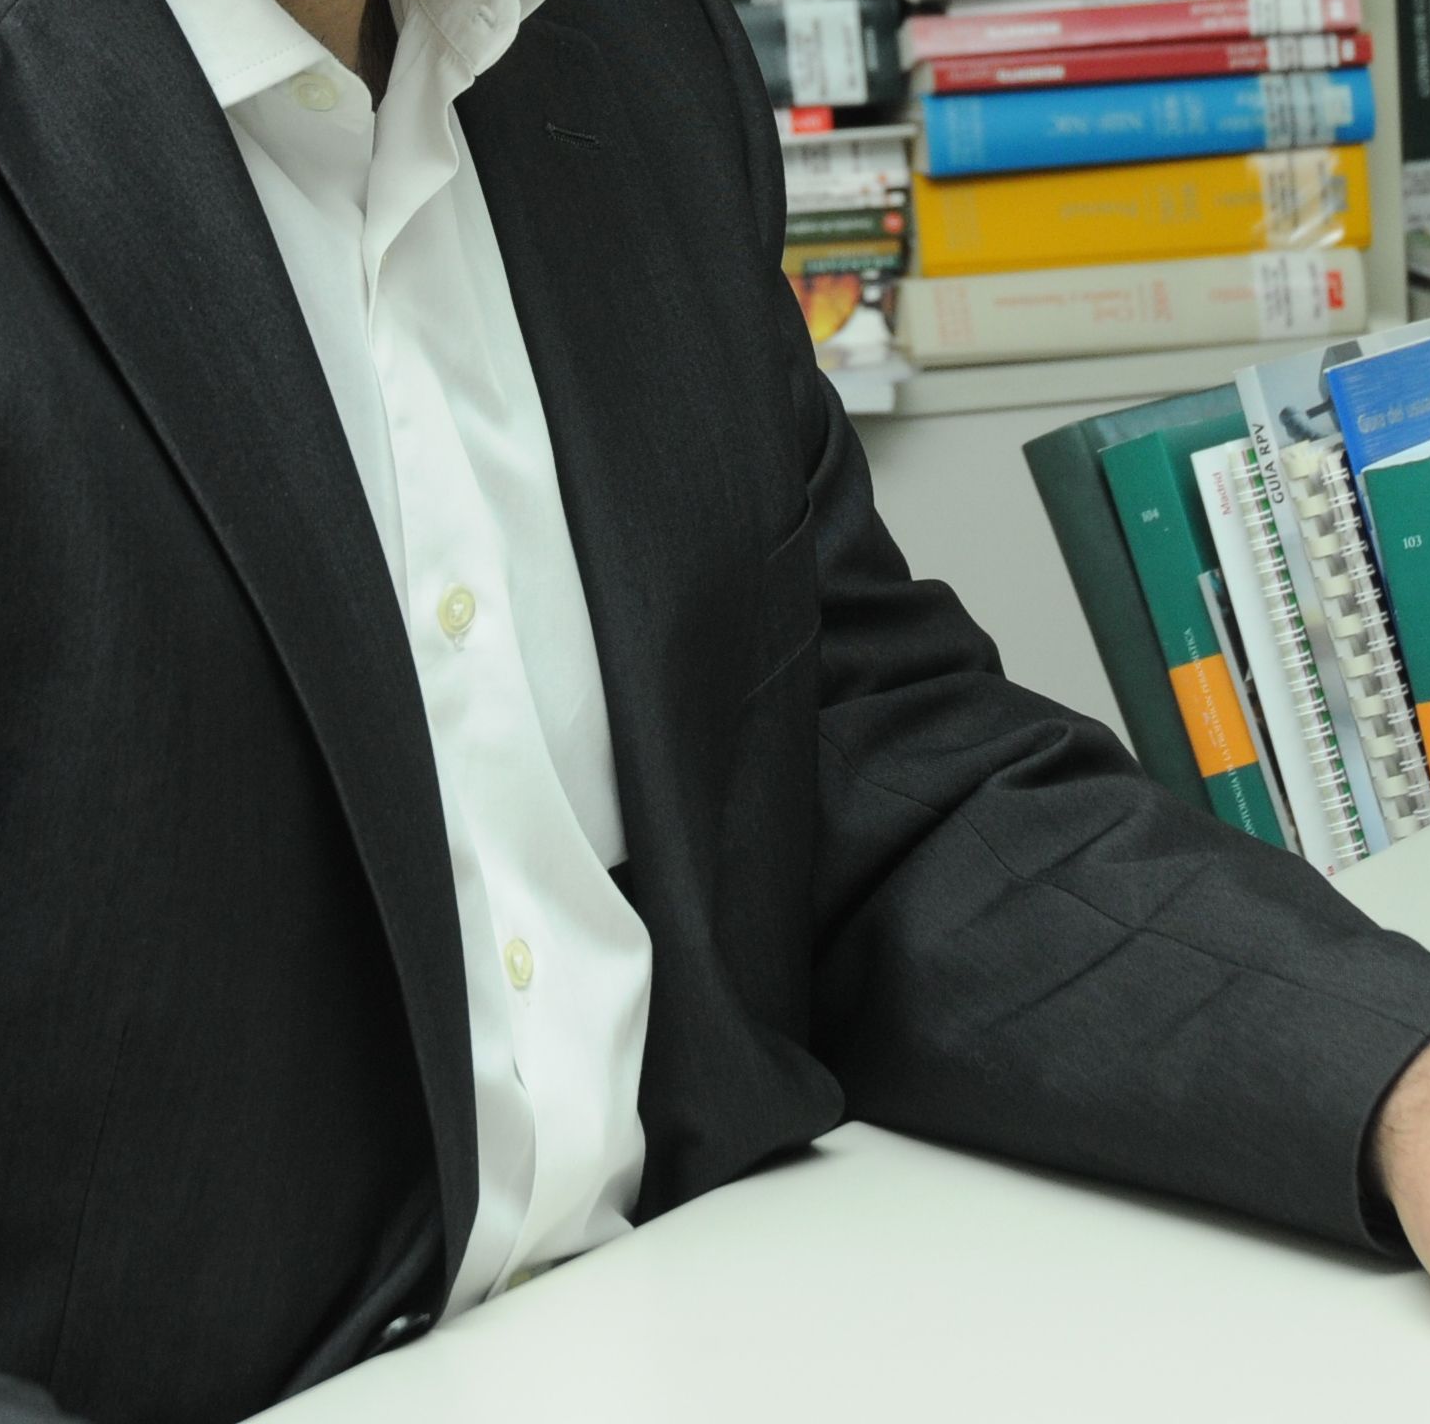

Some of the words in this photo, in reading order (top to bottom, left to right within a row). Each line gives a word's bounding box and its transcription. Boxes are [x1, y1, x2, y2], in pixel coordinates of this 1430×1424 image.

[1252, 423, 1272, 456] RPV
[1212, 470, 1232, 515] Madrid
[1262, 460, 1285, 504] GUÍA
[1402, 534, 1422, 550] 103
